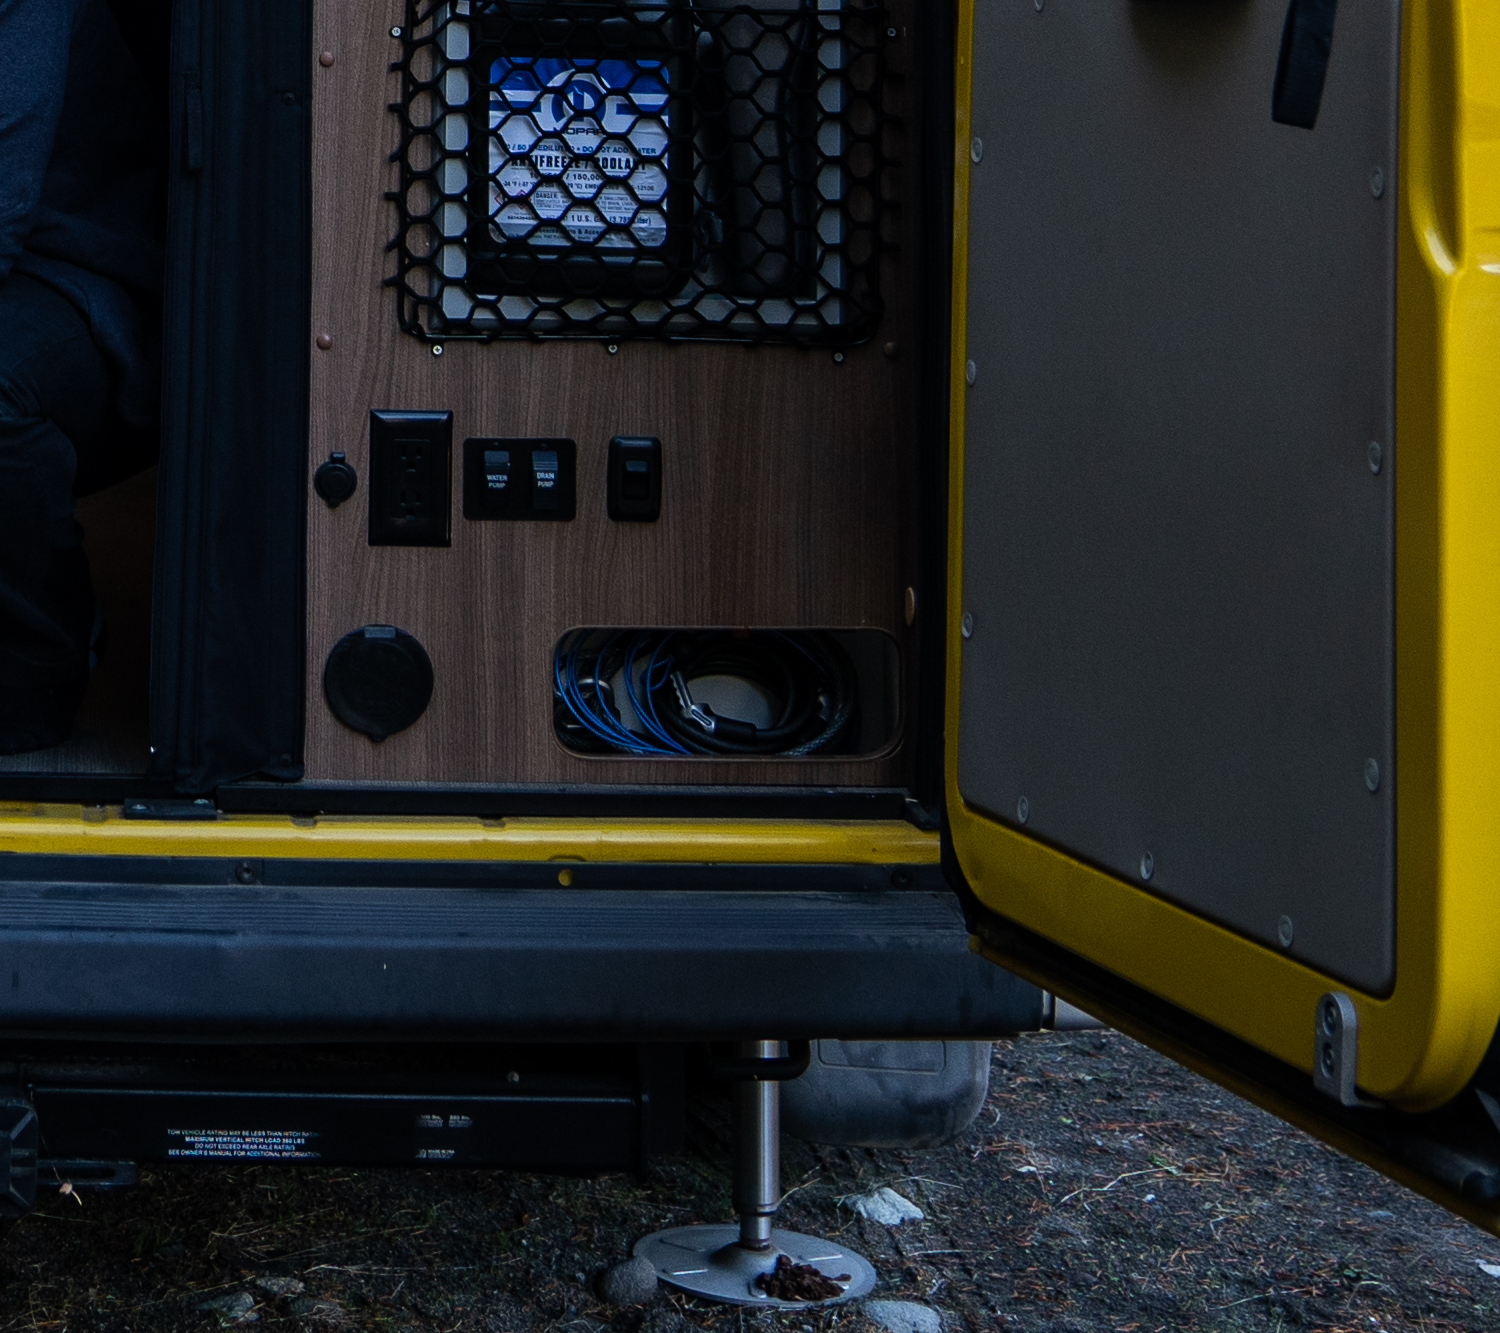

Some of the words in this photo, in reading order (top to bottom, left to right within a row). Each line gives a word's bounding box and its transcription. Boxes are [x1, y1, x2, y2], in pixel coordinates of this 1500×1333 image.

[486, 474, 508, 482] WATER
[536, 472, 555, 480] DRAIN
[537, 480, 555, 488] PUMP
[167, 1128, 181, 1136] TOW
[208, 1149, 233, 1157] MANUAL
